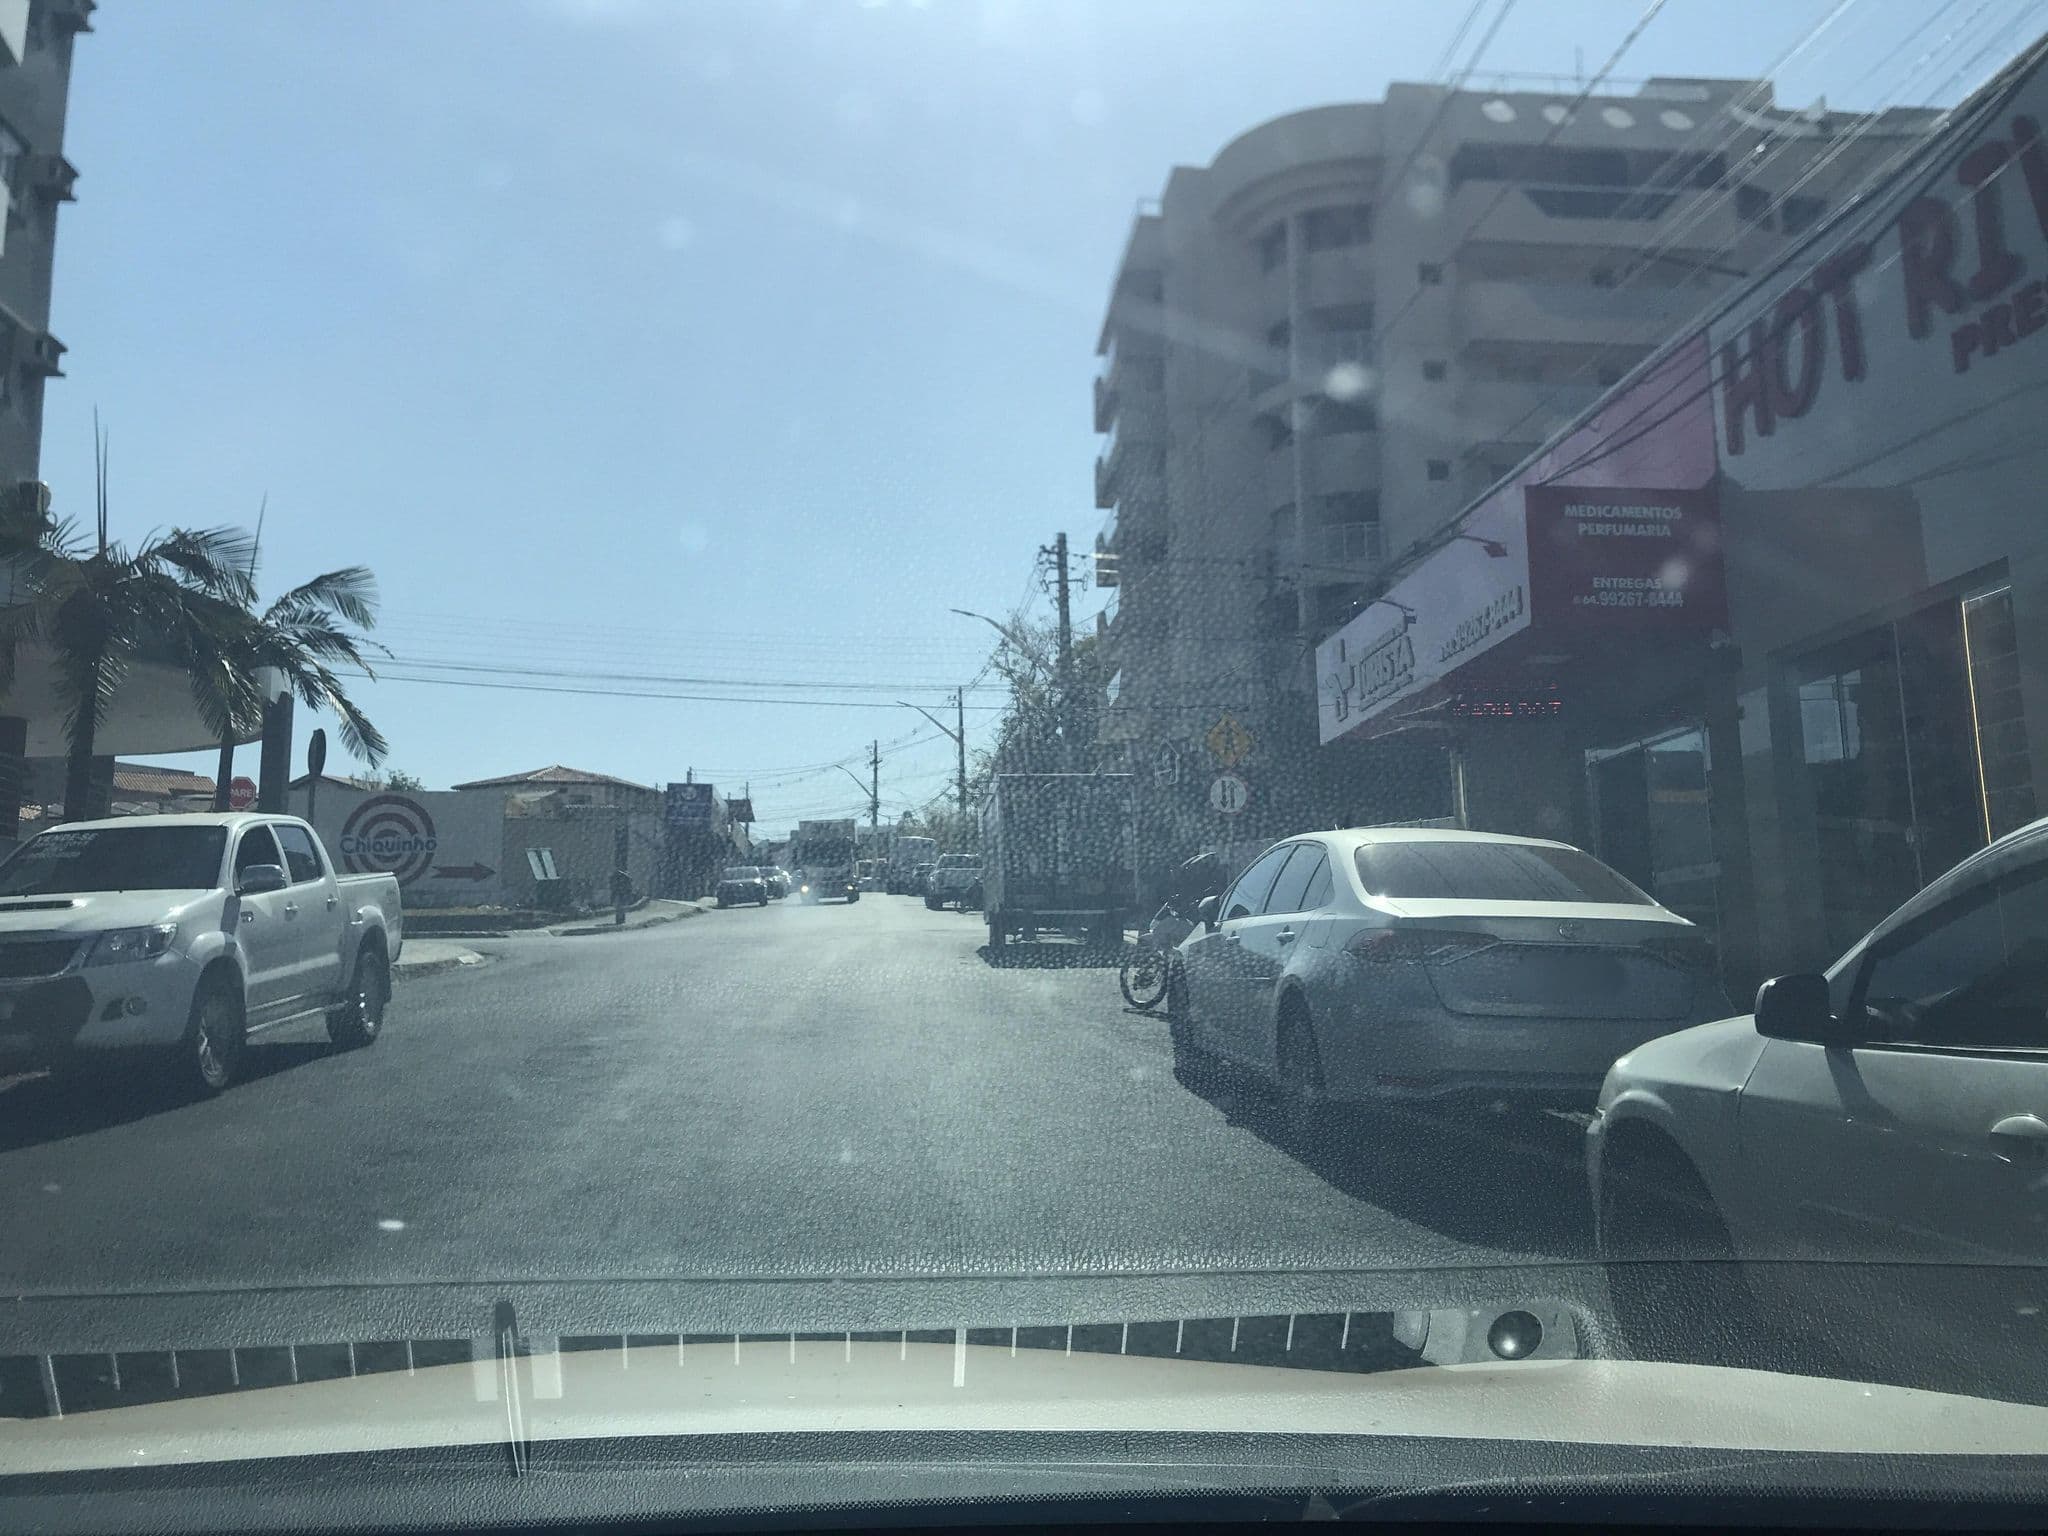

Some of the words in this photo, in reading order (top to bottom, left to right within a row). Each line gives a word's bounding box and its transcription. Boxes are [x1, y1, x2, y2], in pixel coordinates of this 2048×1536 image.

[1950, 277, 2048, 374] PRE
[1722, 241, 1872, 455] HOT
[1563, 504, 1683, 520] MEDICAMENTOS
[1577, 522, 1672, 537] PERFUMARIA
[1592, 576, 1664, 590] ENTREGAS
[339, 835, 438, 854] Chiquinho
